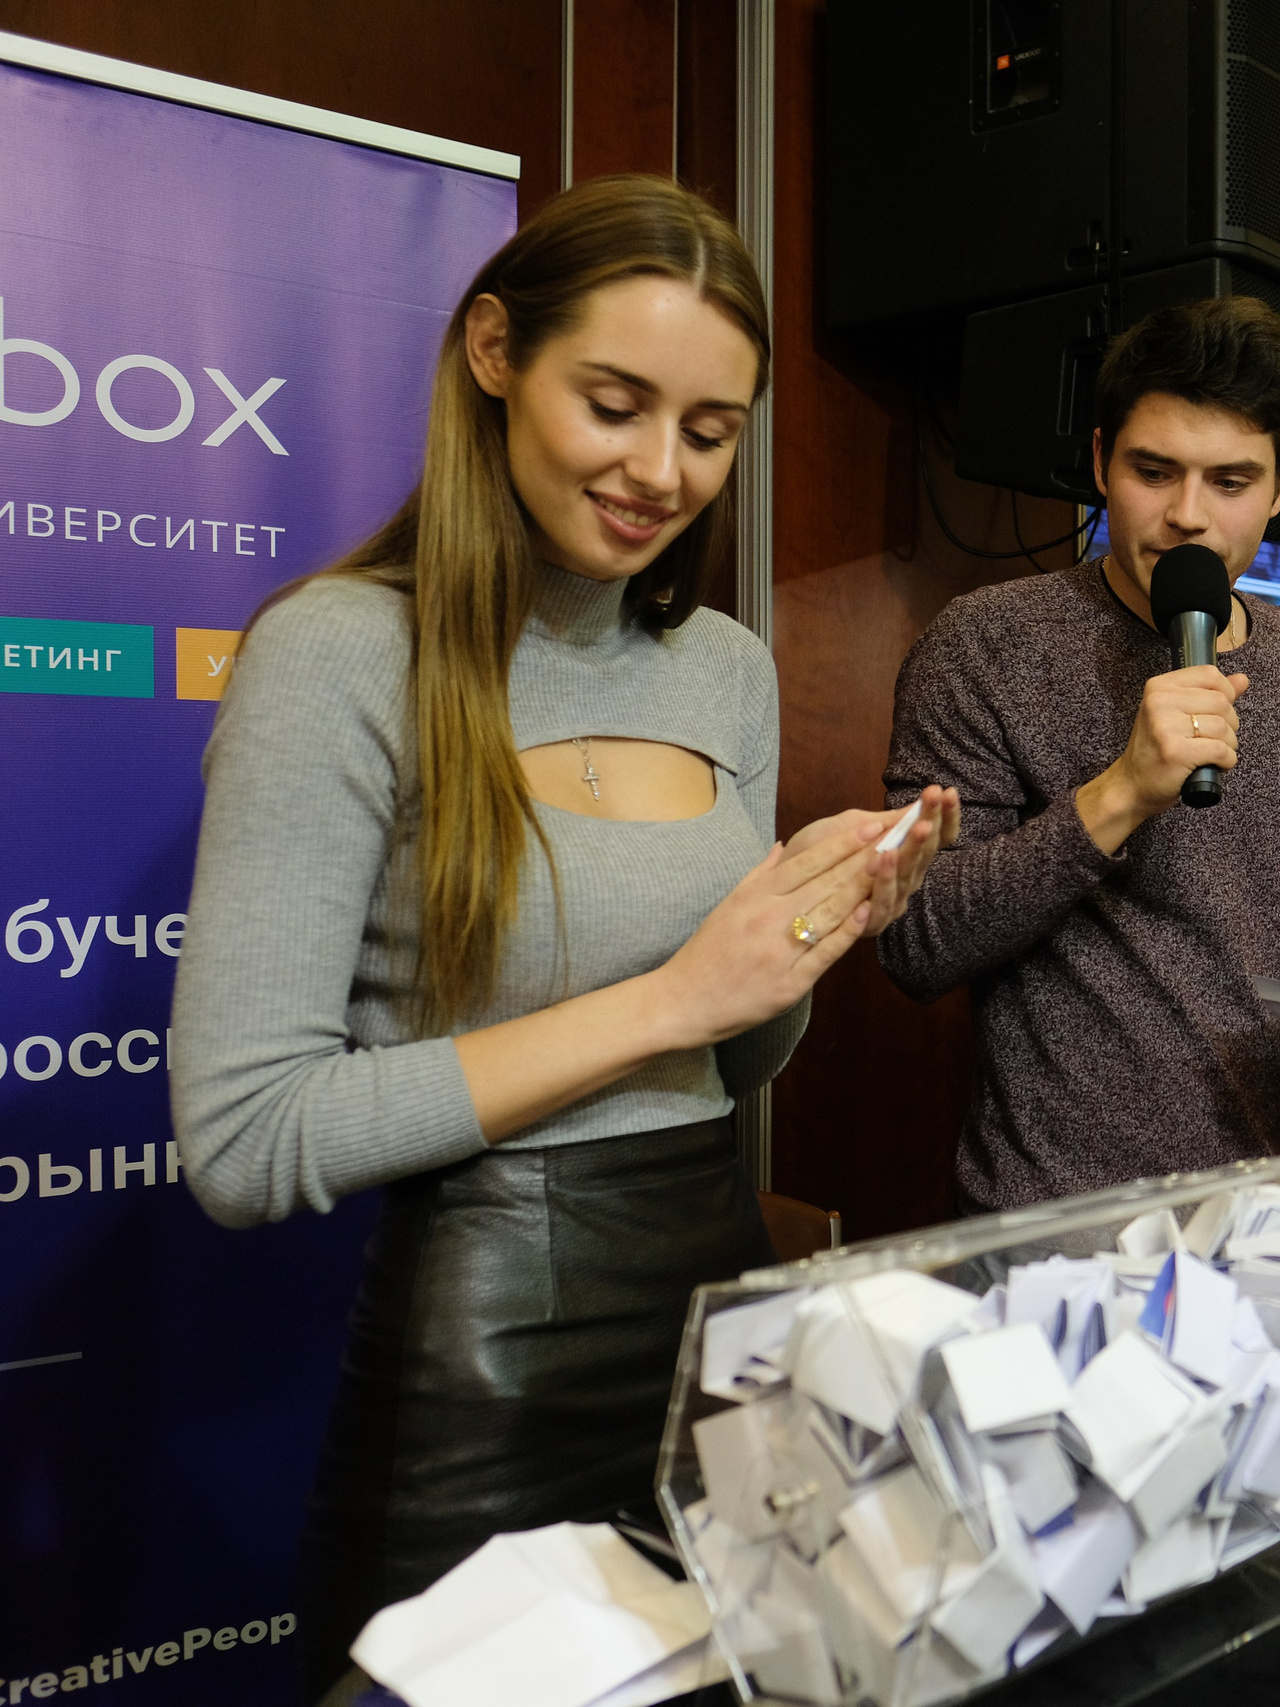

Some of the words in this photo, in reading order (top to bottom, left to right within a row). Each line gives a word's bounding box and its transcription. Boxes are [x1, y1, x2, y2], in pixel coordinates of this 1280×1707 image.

[0, 296, 289, 456] box
[3, 644, 122, 672] ЕТИНГ
[0, 1028, 173, 1081] осс
